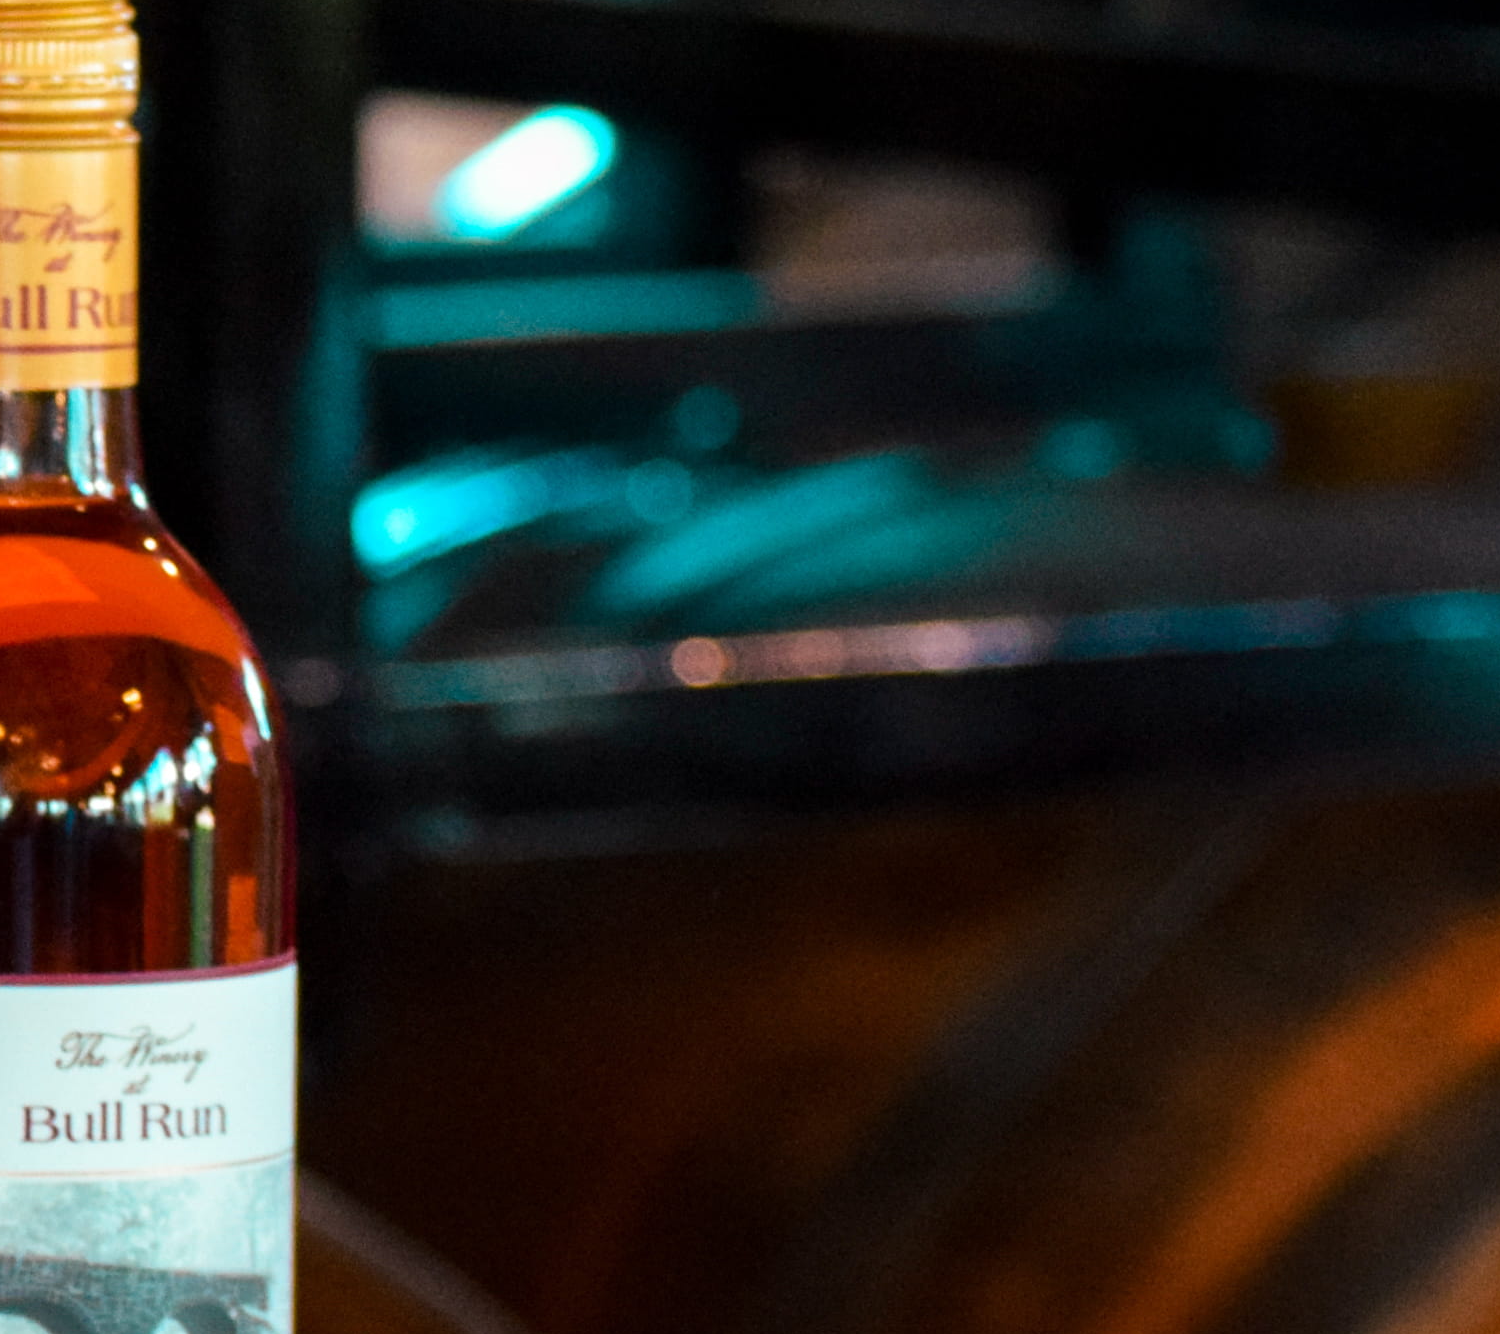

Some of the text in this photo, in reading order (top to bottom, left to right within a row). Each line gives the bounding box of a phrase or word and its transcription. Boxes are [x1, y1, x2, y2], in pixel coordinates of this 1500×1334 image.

[43, 201, 122, 264] Winery
[43, 253, 74, 273] at
[55, 1021, 207, 1084] The Winery
[122, 1072, 150, 1095] at
[22, 1100, 228, 1143] Bull Run
